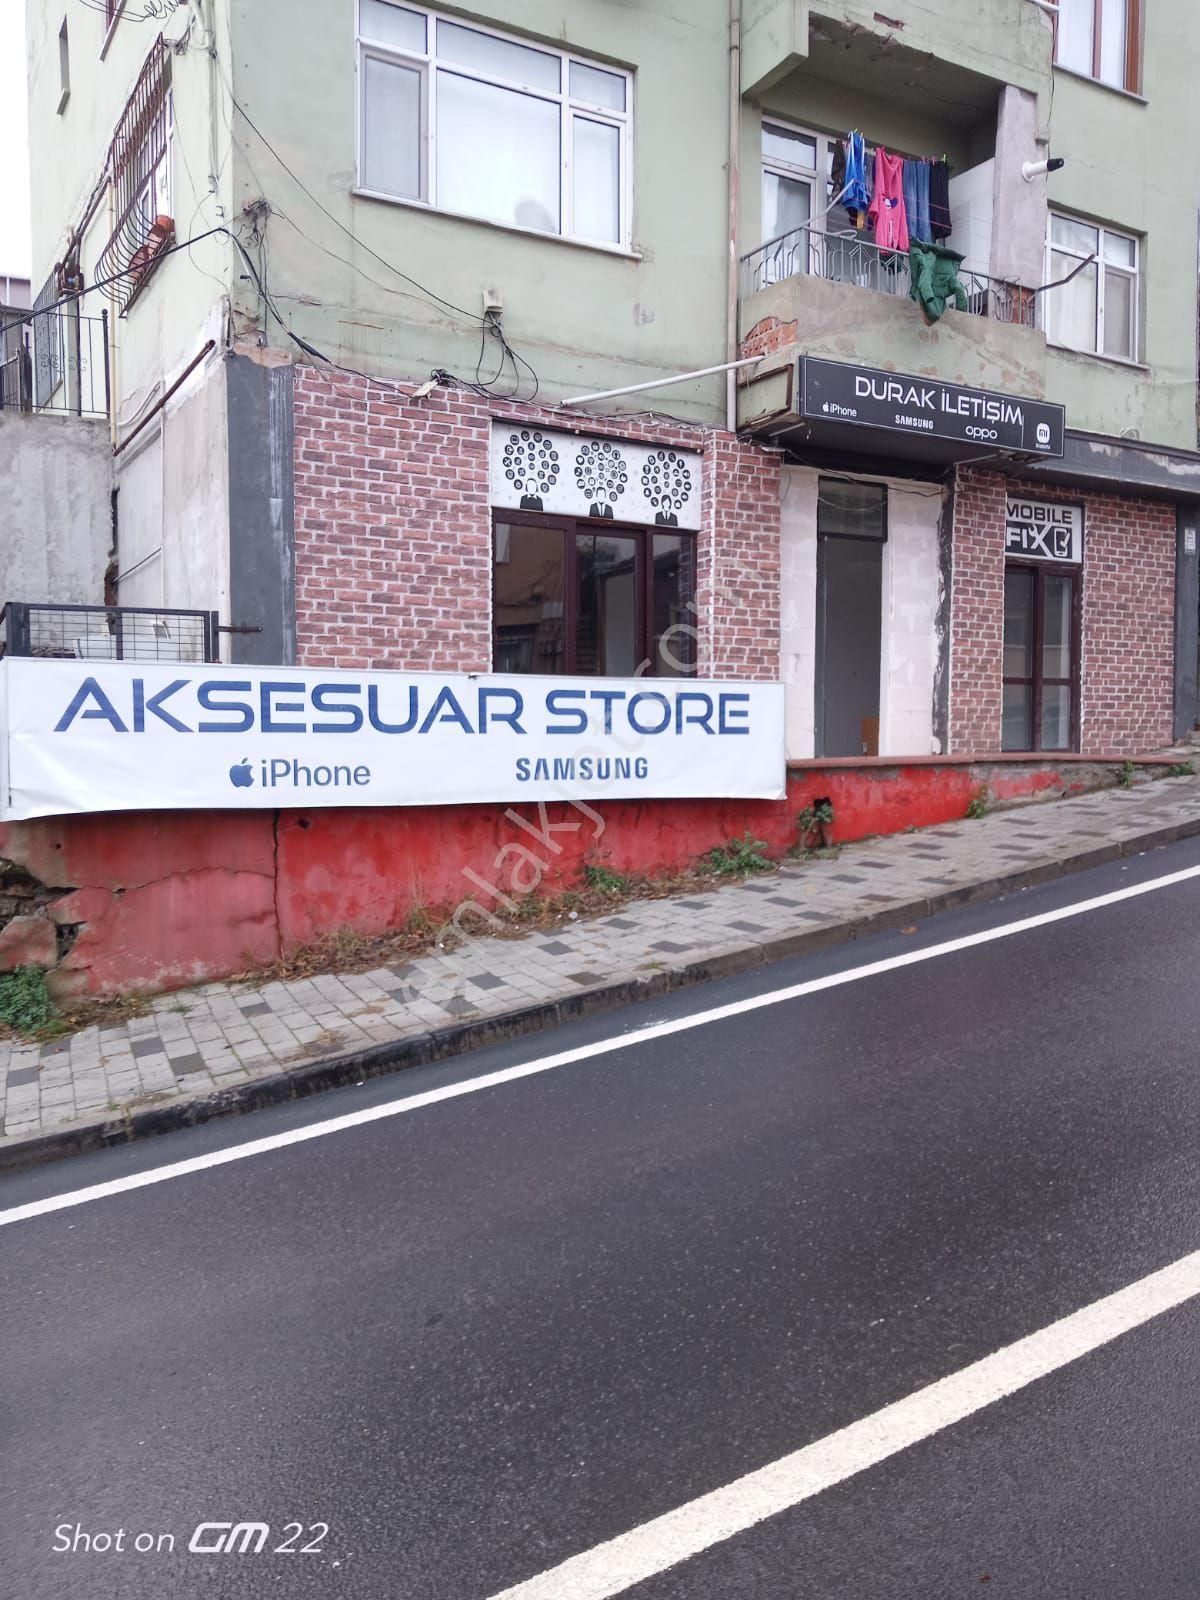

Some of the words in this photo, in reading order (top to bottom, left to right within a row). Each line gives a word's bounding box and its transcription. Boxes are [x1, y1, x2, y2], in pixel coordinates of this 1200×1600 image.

[829, 403, 857, 417] iPhone
[895, 414, 933, 430] SAMSUNG
[1006, 503, 1072, 525] MOBILE
[1006, 523, 1052, 559] FIX
[53, 676, 527, 734] AKSESUAR
[545, 689, 750, 735] STORE
[261, 758, 371, 787] iPhone
[515, 757, 649, 781] SAMSUNG
